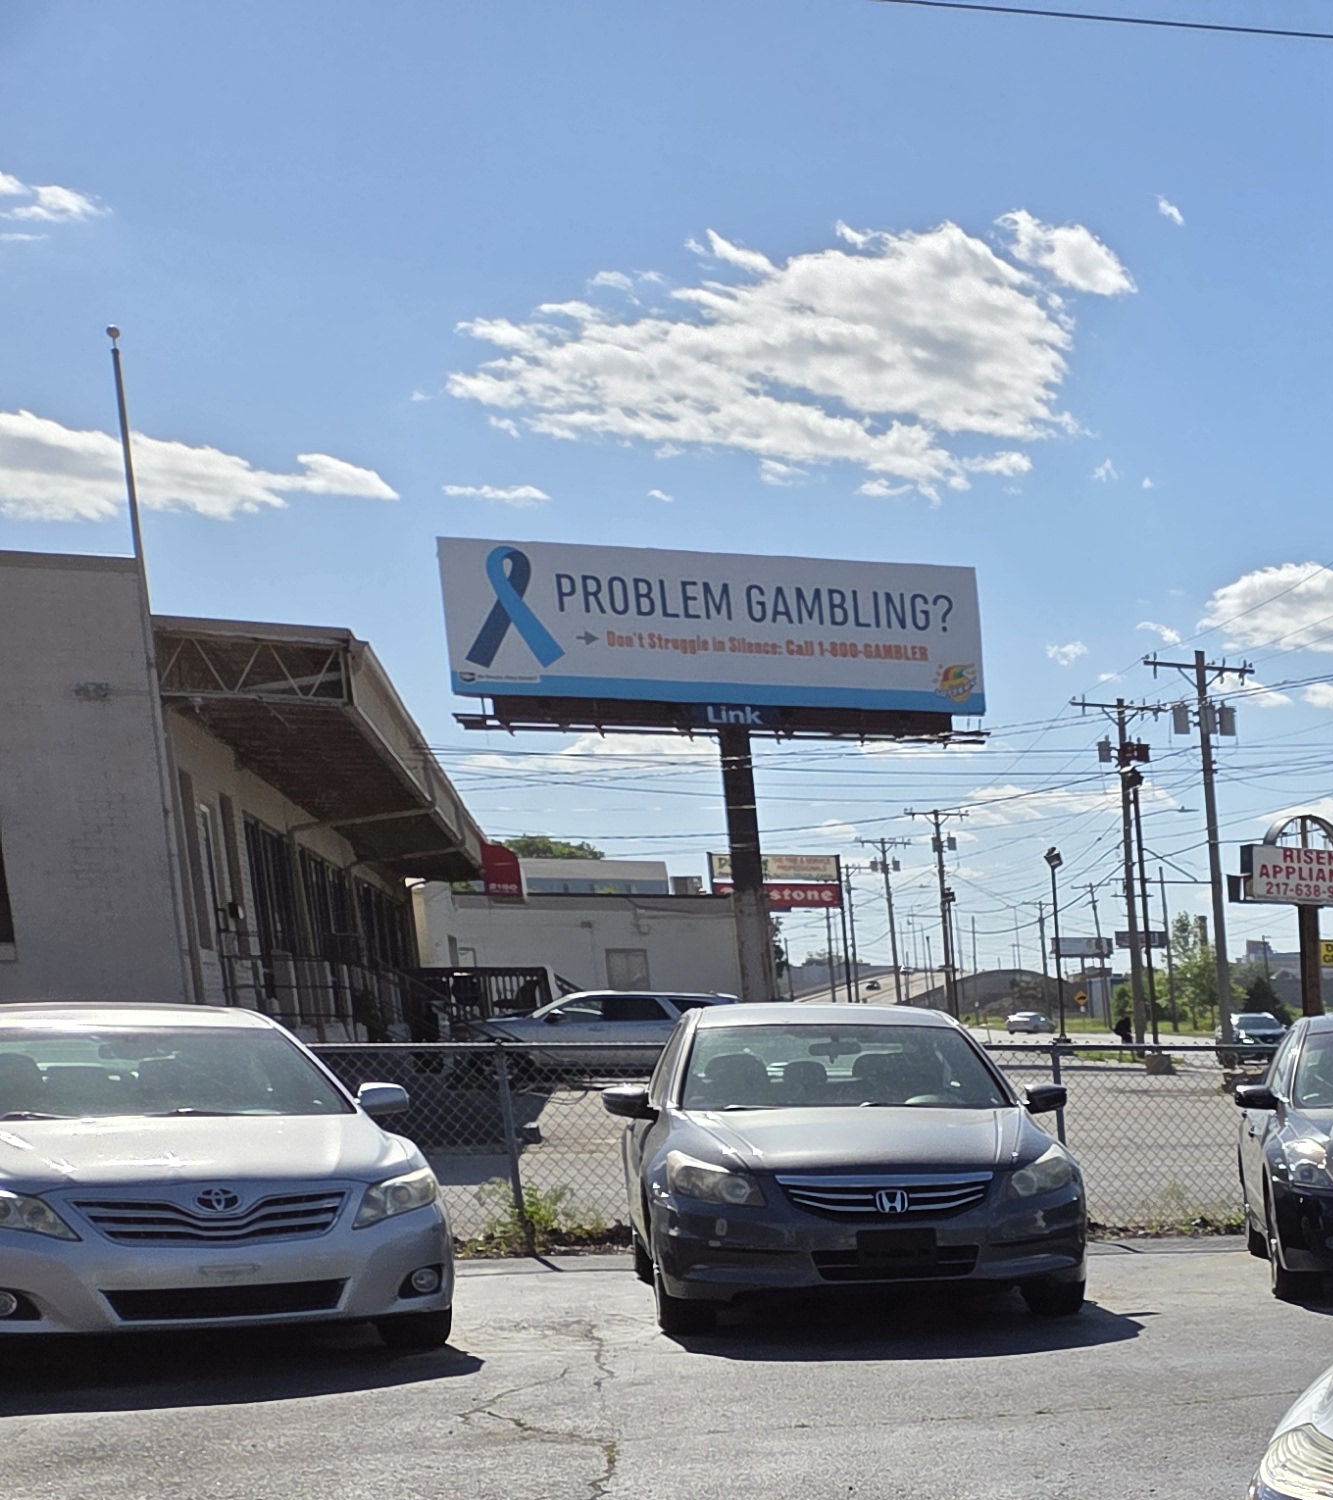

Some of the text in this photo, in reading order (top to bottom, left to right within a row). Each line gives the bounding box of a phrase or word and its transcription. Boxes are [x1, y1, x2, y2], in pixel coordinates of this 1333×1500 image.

[555, 573, 953, 633] PROBLEM GAMBLING?
[606, 630, 645, 648] Don't
[648, 632, 709, 655] Struggle
[712, 636, 726, 651] in
[785, 639, 815, 656] Call
[817, 640, 929, 661] 1-800-GAMBLER
[706, 705, 763, 725] Link
